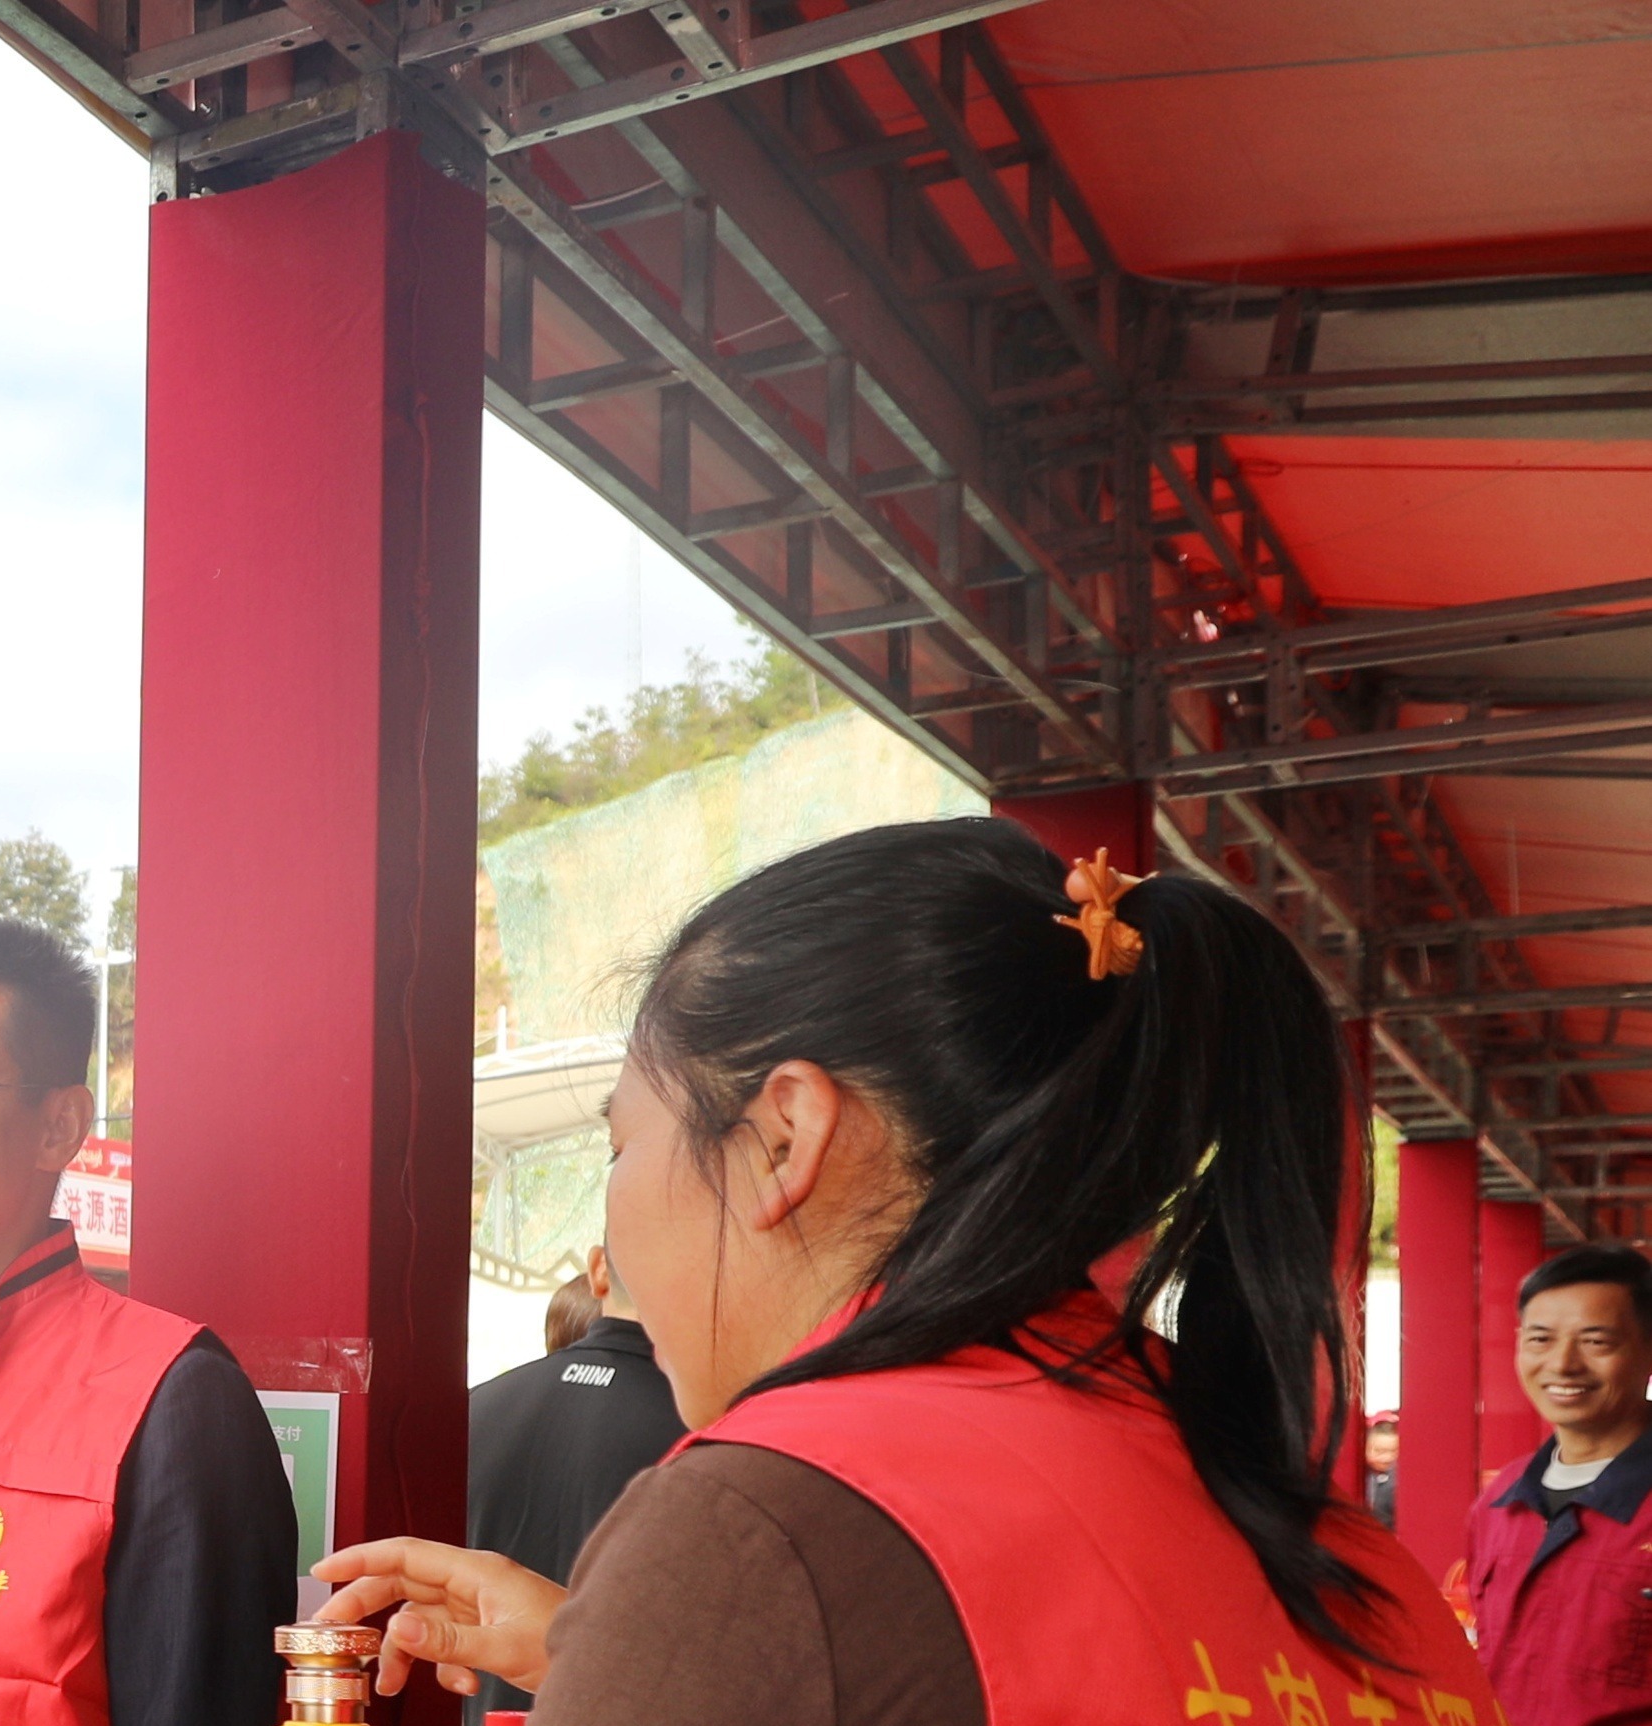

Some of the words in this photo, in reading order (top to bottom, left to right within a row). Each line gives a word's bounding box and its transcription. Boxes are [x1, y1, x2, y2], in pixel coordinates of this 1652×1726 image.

[51, 1188, 128, 1237] 溢源酒
[561, 1362, 615, 1388] CHINA
